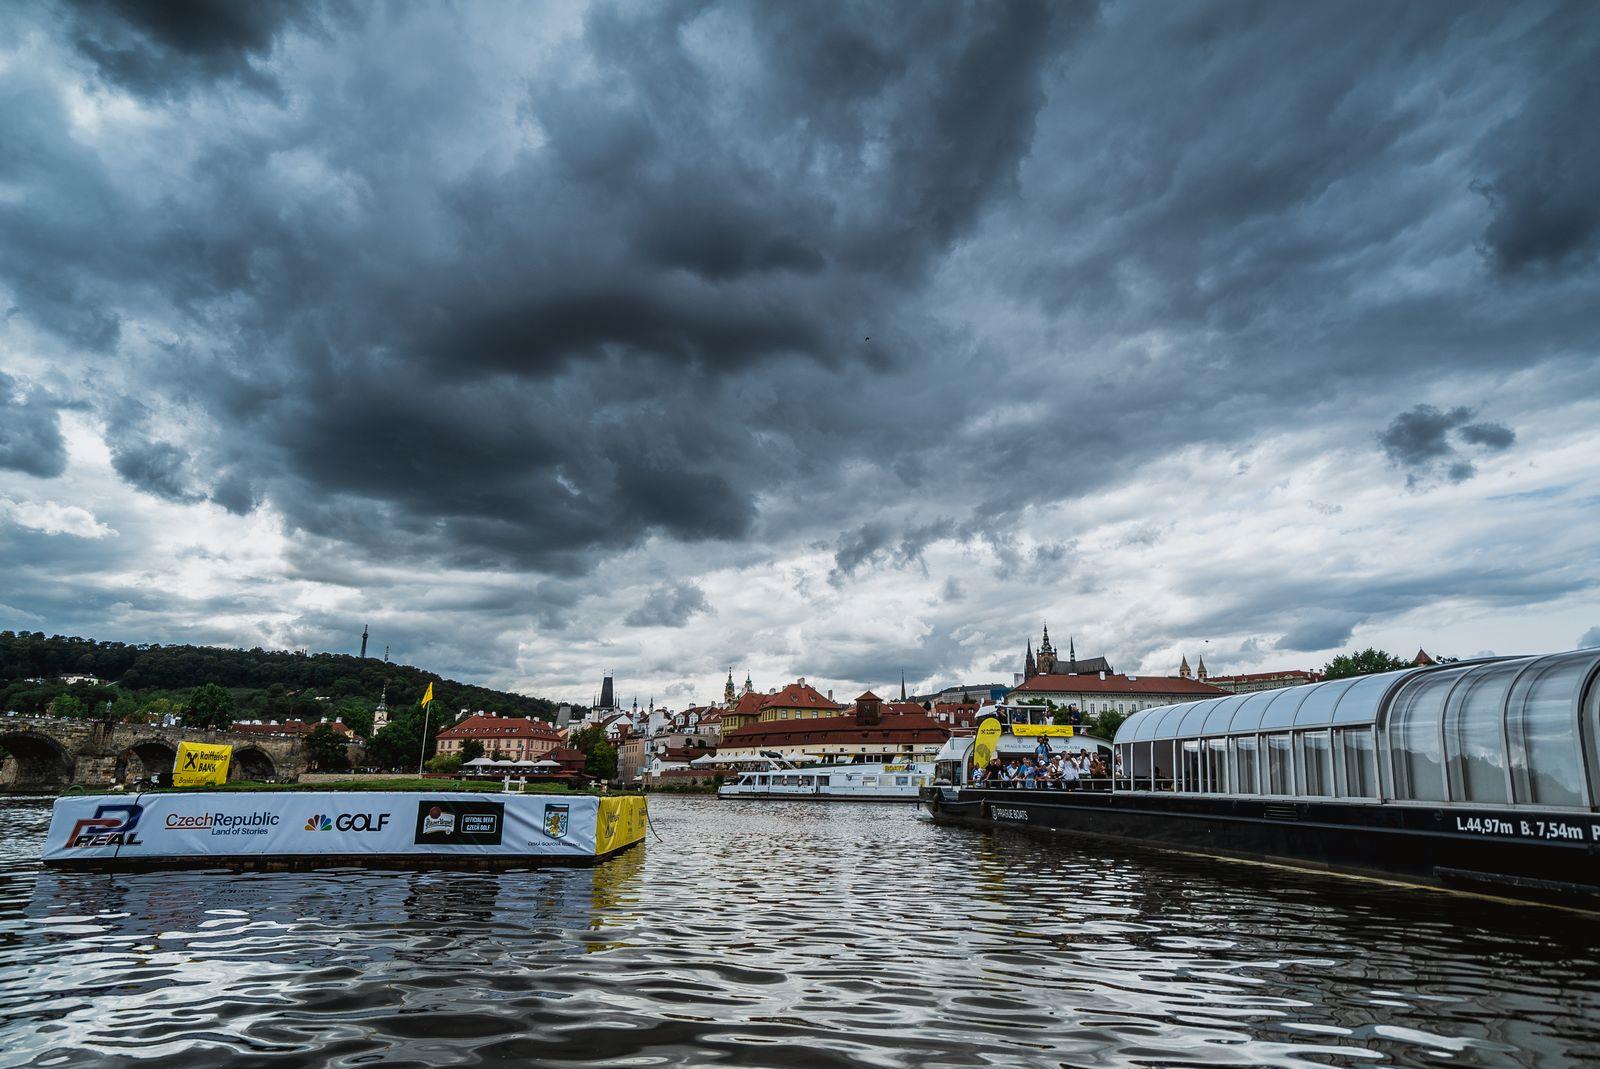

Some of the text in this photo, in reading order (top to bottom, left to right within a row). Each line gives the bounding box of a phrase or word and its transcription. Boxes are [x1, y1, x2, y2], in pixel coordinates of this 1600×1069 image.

[198, 762, 217, 773] BANK
[335, 813, 391, 832] GOLF
[1456, 816, 1514, 834] L.44,97m
[211, 827, 268, 835] Land of Stories
